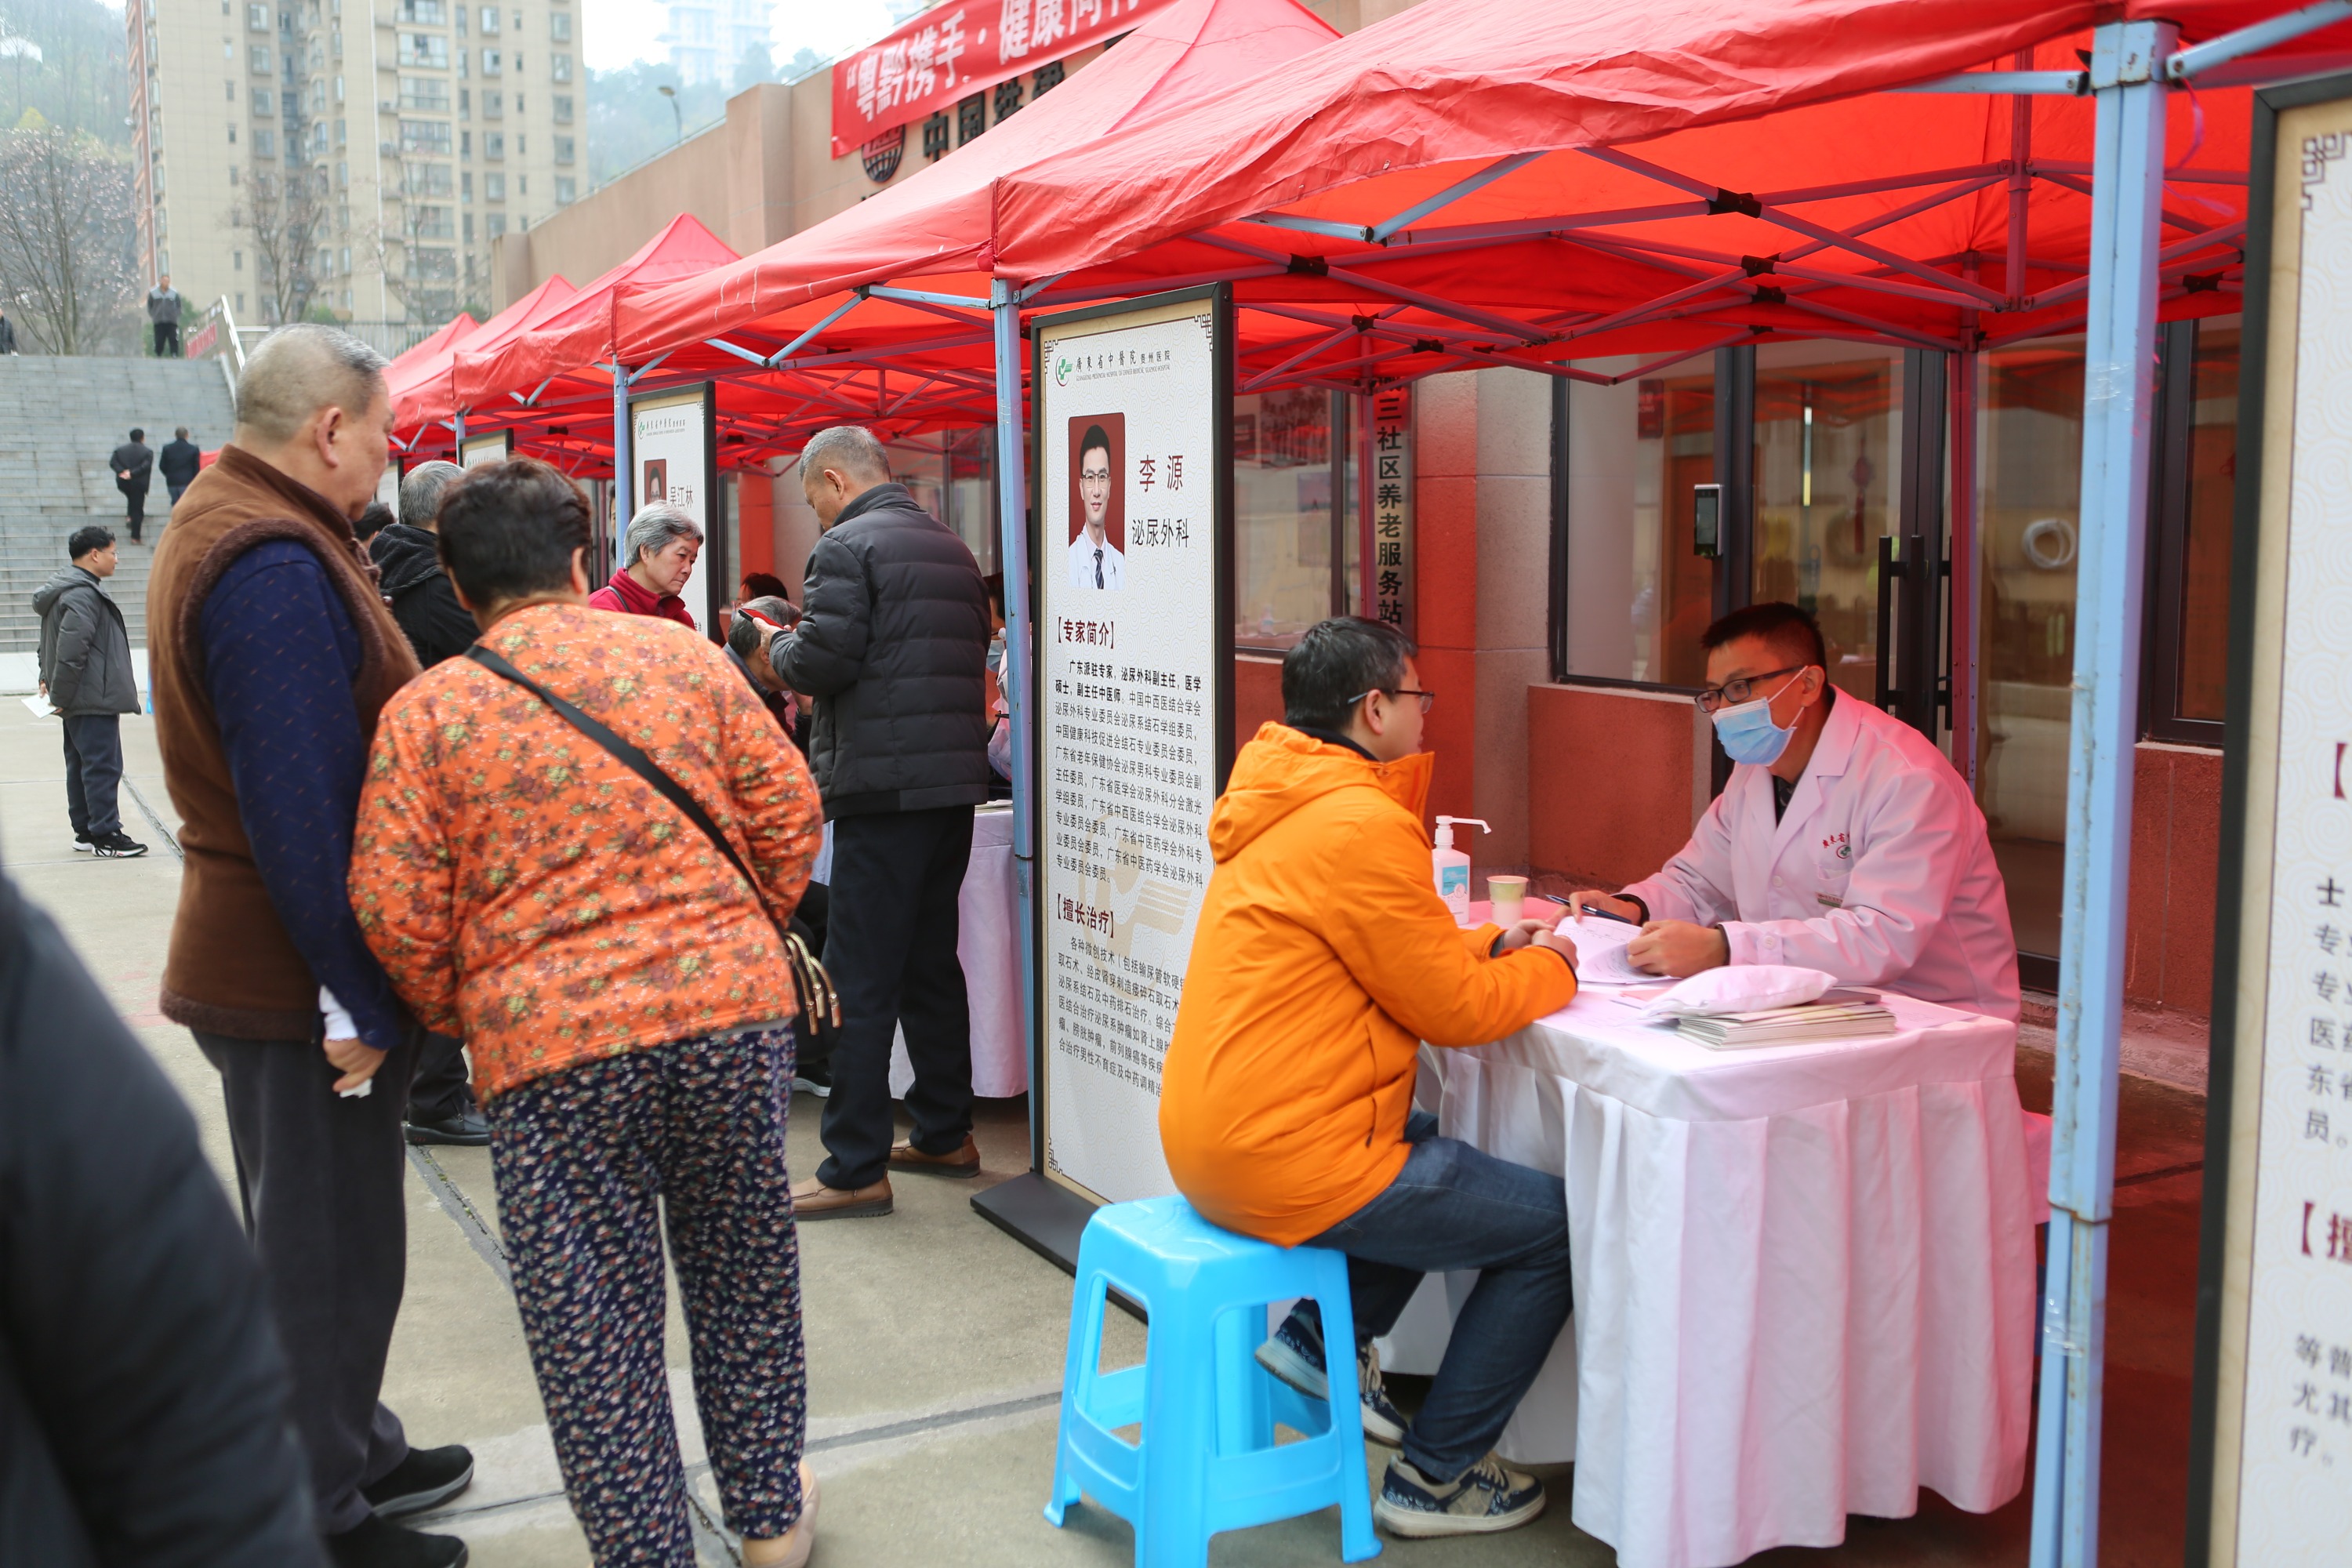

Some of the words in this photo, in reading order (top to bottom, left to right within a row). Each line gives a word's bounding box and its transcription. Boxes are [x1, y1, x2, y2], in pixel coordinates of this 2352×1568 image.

[846, 0, 1138, 123] “粤黔携手·健康
[1139, 454, 1183, 493] 李源
[670, 485, 694, 509] 吴江林
[1131, 517, 1189, 548] 泌尿外科
[1058, 616, 1114, 650] 【专家简介】
[1058, 893, 1114, 938] 【擅长治疗】
[1058, 974, 1177, 1035] 泌尿系结石及中药排石治疗。综合
